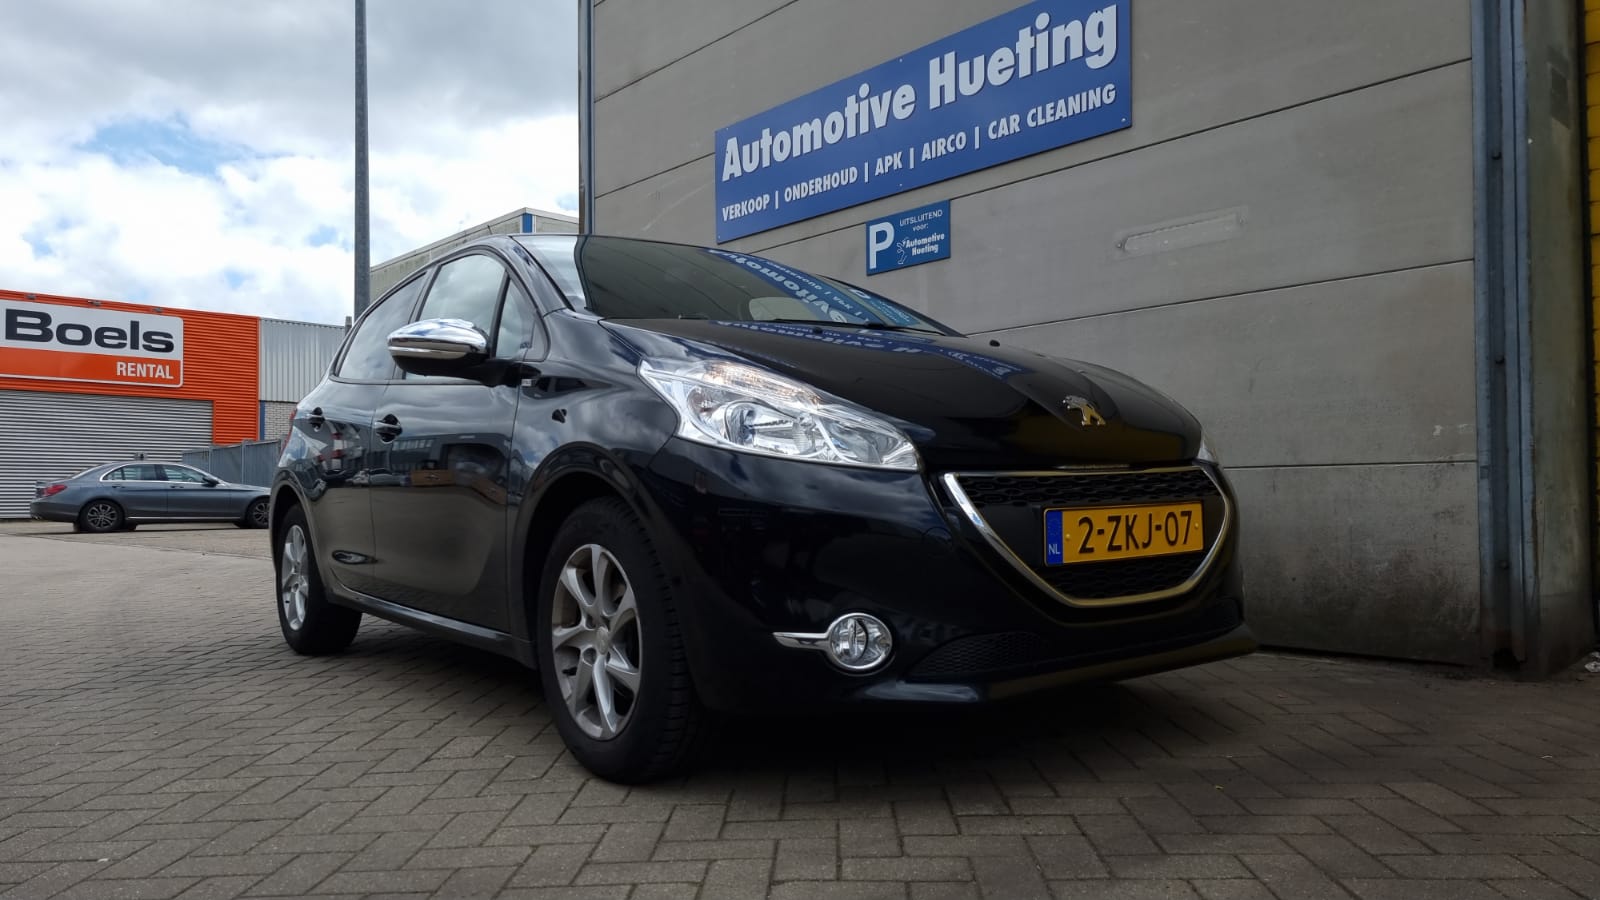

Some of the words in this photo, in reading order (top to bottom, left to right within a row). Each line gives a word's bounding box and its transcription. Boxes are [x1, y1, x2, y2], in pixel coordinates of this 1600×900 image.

[722, 83, 916, 181] Automotive
[929, 4, 1117, 110] Hueting
[722, 194, 770, 222] VERKOOP
[784, 167, 858, 202] ONDERHOUD
[875, 151, 903, 176] APK
[921, 131, 967, 162] AIRCO
[988, 114, 1020, 140] CAR
[1027, 84, 1116, 128] CLEANING
[900, 209, 943, 227] UITSLUITEND
[869, 222, 895, 270] P
[905, 233, 945, 248] Automotive
[5, 308, 175, 353] Boels
[116, 361, 174, 380] RENTAL
[1048, 543, 1060, 555] NL
[1078, 510, 1192, 554] 2-ZKJ-07
